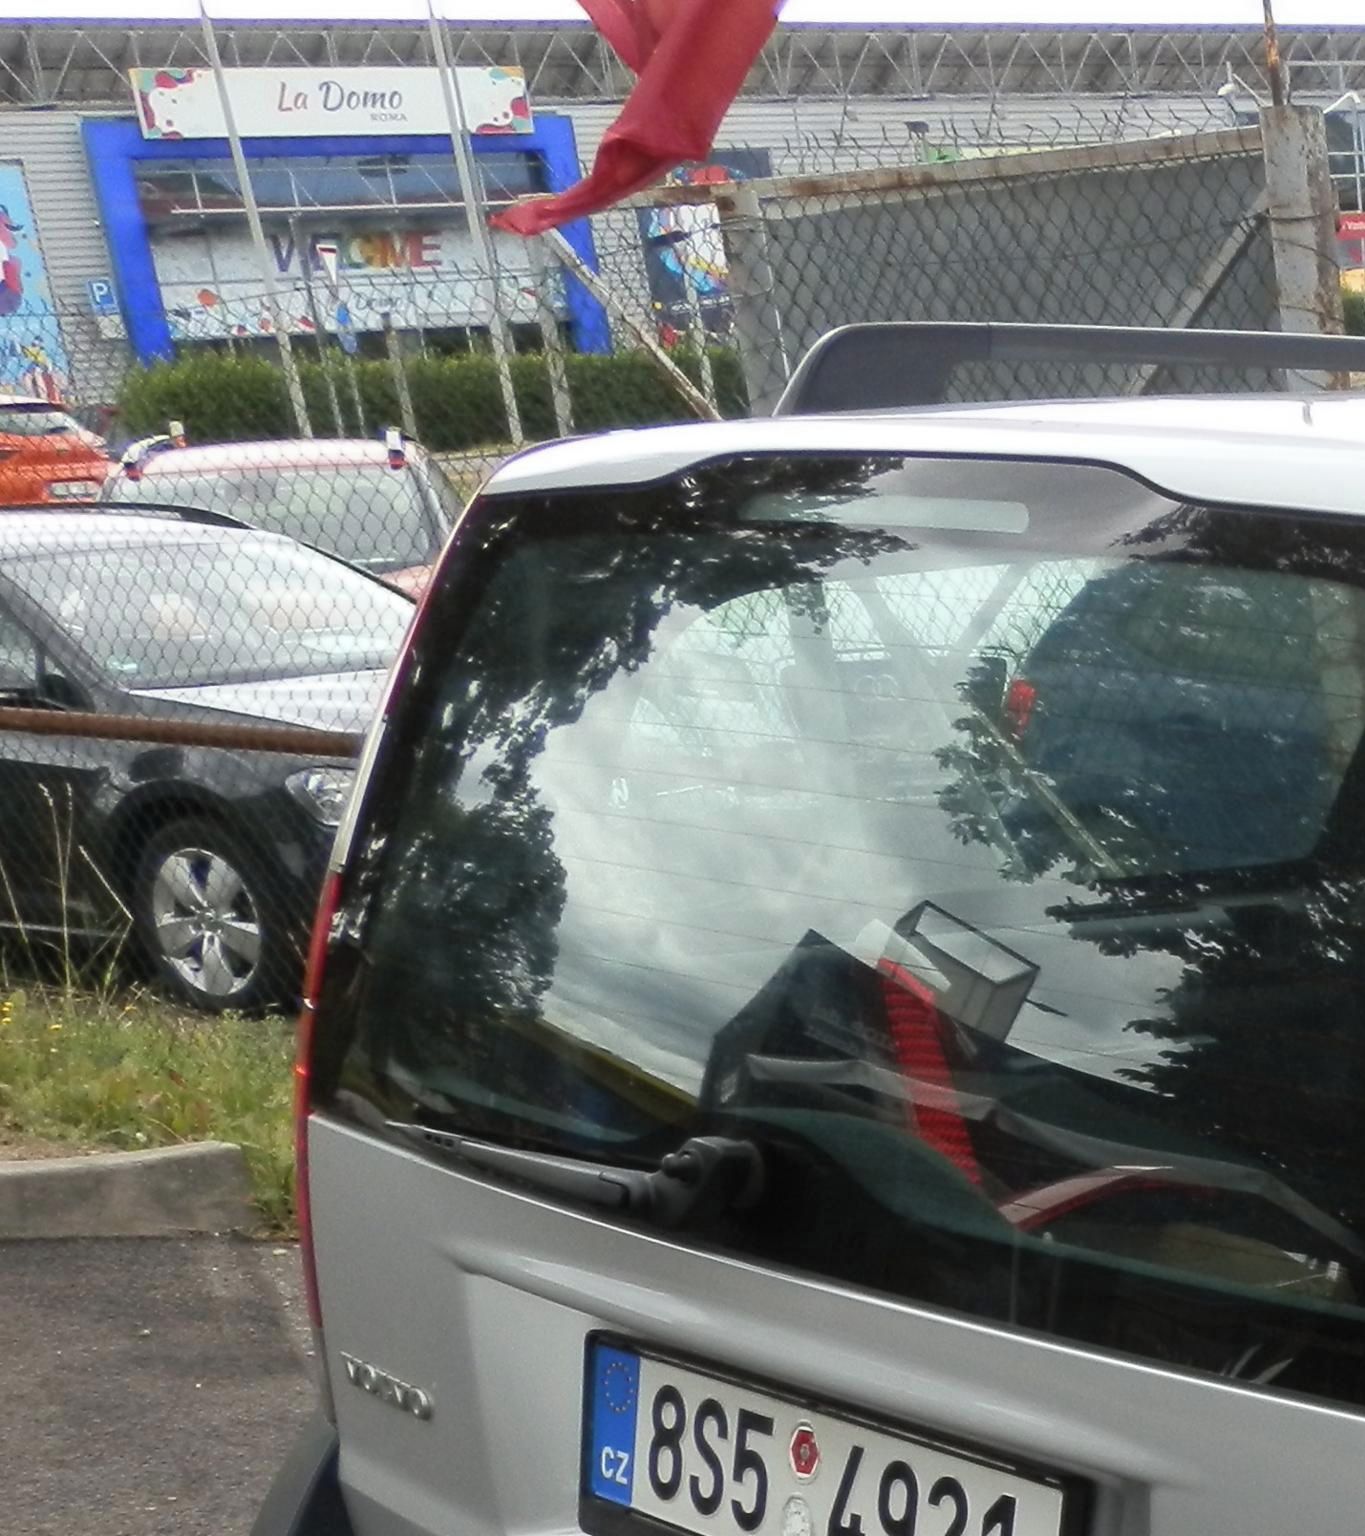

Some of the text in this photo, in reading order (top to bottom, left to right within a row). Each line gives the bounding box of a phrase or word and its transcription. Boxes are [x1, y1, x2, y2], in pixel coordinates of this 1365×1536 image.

[278, 80, 403, 112] La Domo
[92, 282, 108, 303] P
[340, 1351, 434, 1422] VOLVO
[601, 1446, 628, 1485] CZ
[648, 1384, 775, 1532] 8S5
